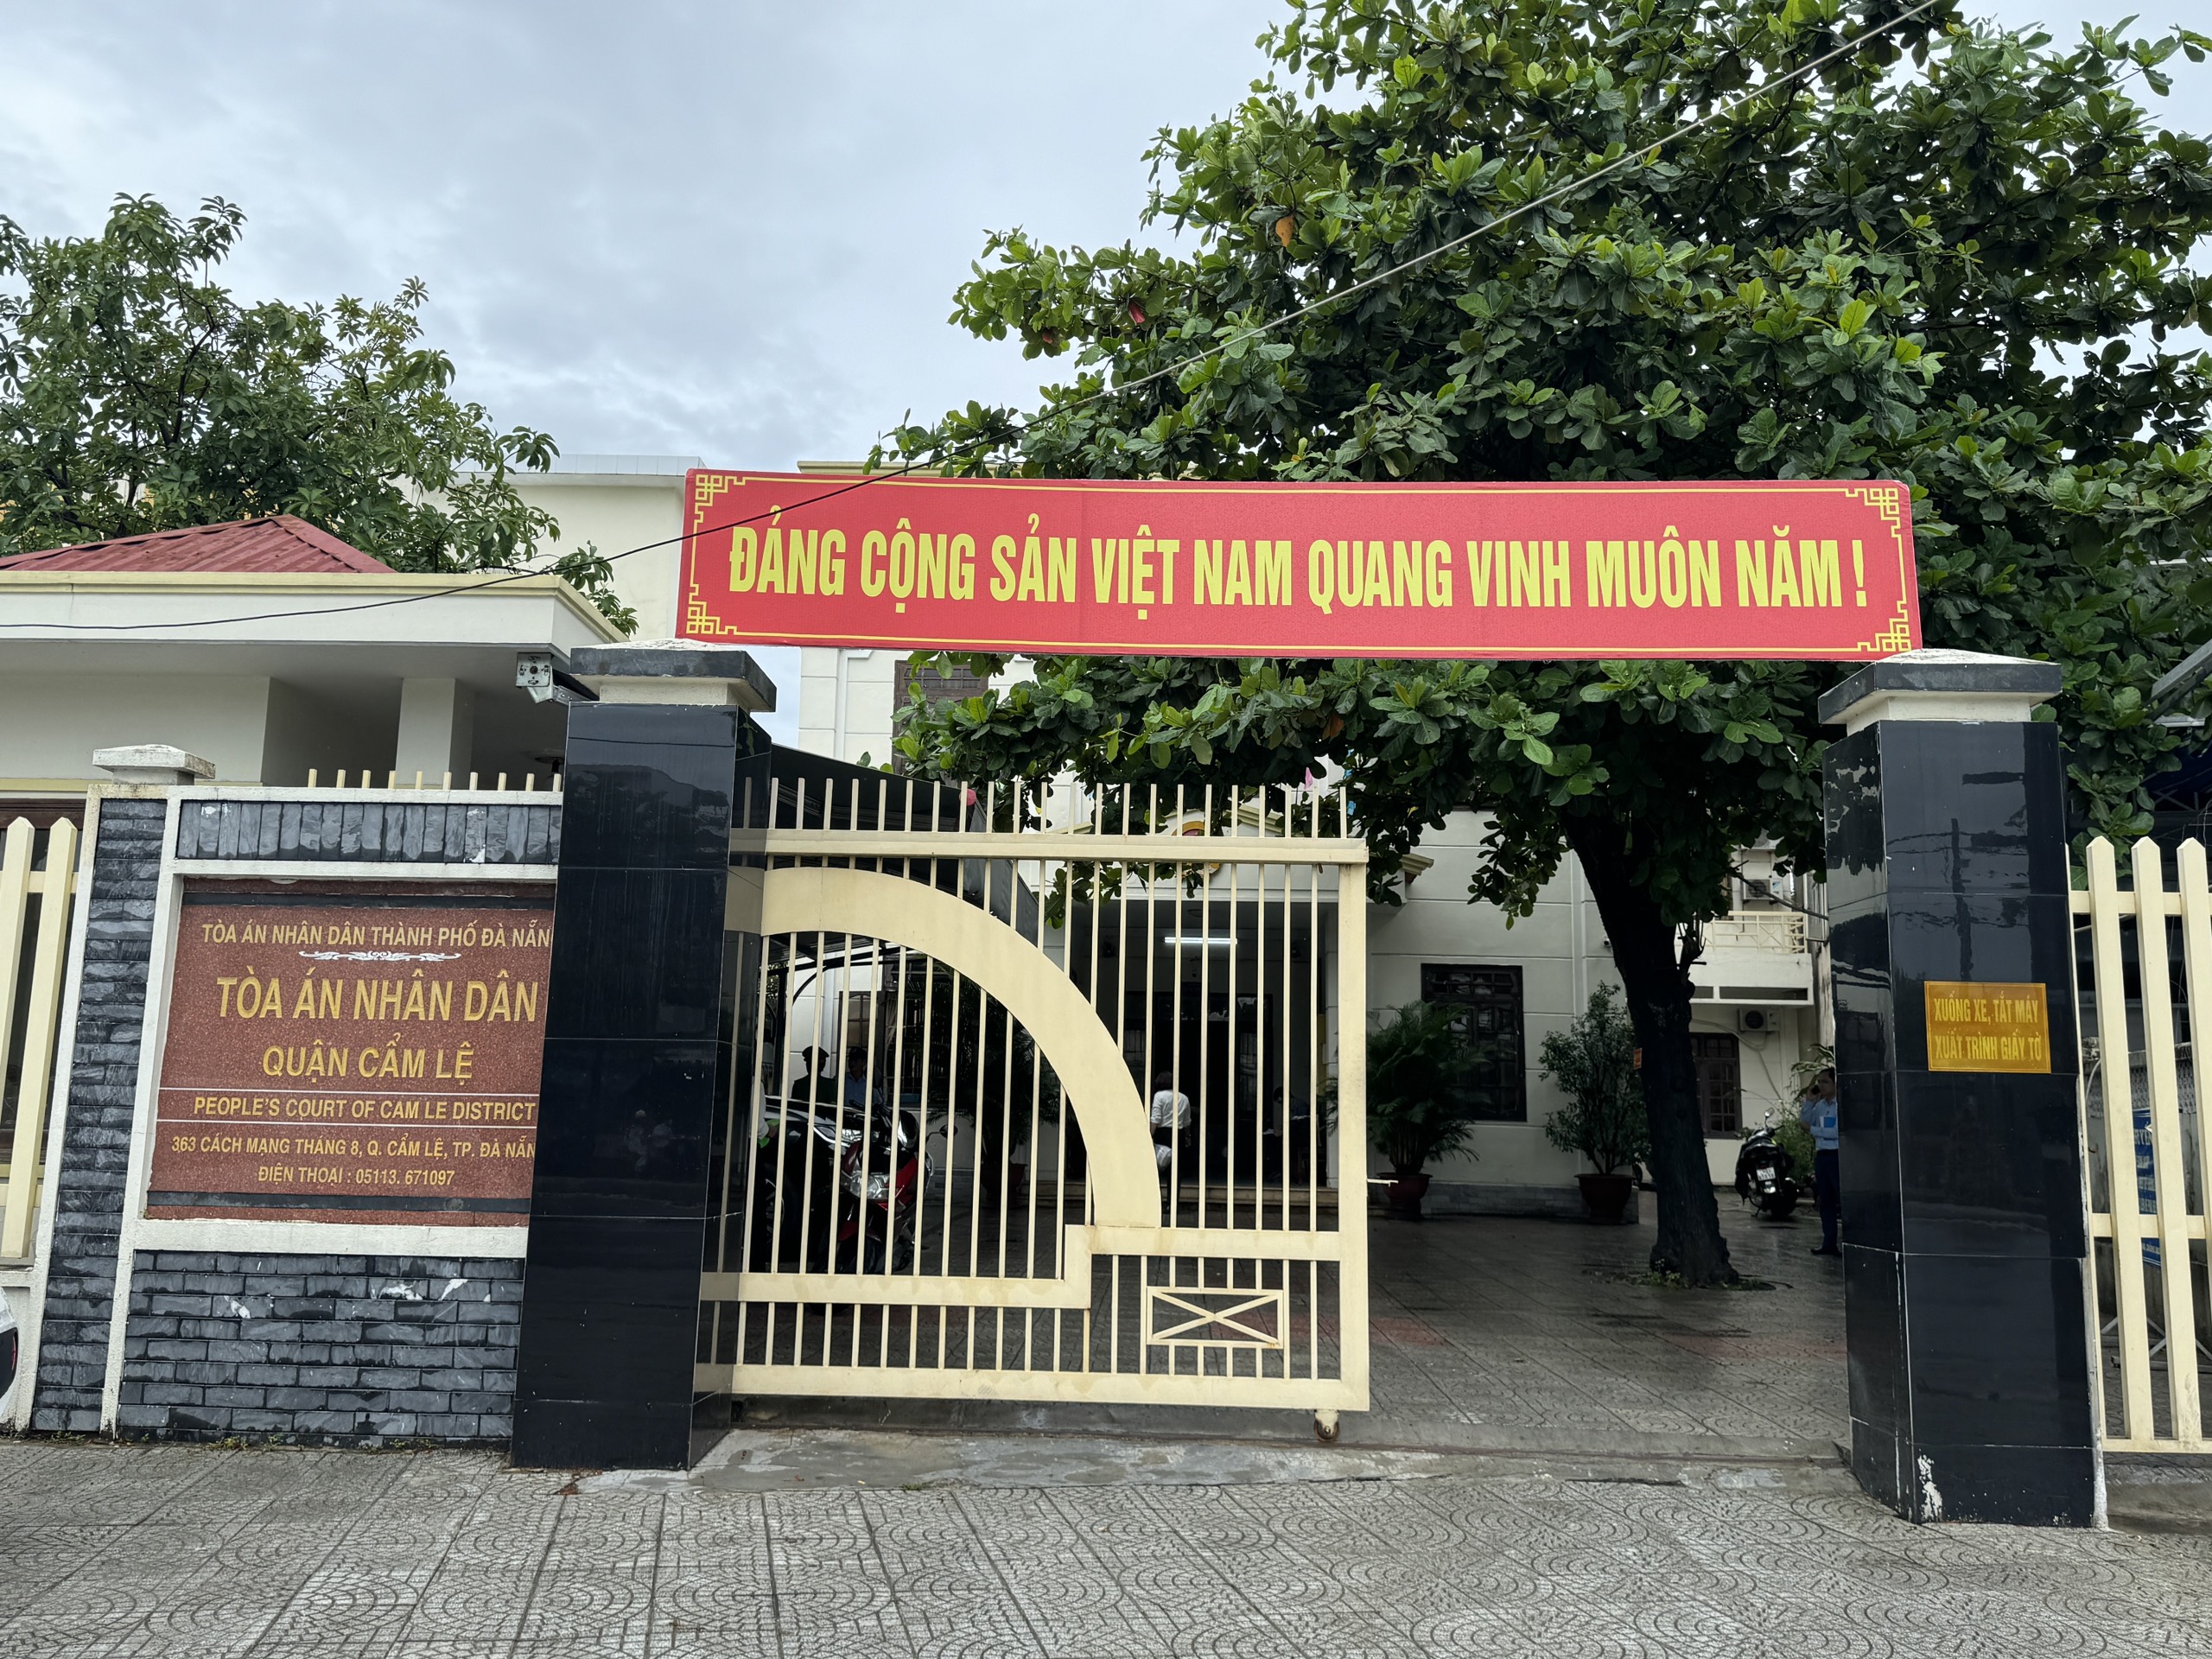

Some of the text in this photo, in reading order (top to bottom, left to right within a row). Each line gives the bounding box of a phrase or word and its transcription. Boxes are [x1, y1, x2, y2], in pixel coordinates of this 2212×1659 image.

[729, 505, 1867, 620] ĐẢNG CỘNG SẢN VIỆT NAM QUANG VINH MUÔN NĂM !
[201, 918, 550, 947] TÒA ÁN NHÂN DÂN THÀNH PHỐ ĐÀ NẴN
[217, 965, 538, 1022] TÒA ÁN NHÂN DÂN
[1934, 990, 2039, 1025] XUỐNG XE, TẮT MÁY
[263, 1032, 474, 1085] QUẬN CẨM LỆ
[1935, 1027, 2042, 1061] XUẤT TRÌNH GIẤY TỜ
[285, 1098, 347, 1117] COURT
[351, 1100, 375, 1119] OF
[379, 1101, 419, 1119] CAM
[424, 1102, 448, 1120] LE
[452, 1102, 536, 1121] DISTRICT
[171, 1133, 536, 1160] 363 CÁCH MẠNG THÁNG 8, Q. CẨM LỆ, TP. ĐÀ NẴN
[258, 1162, 294, 1185] ĐIỆN
[298, 1166, 343, 1186] THOẠI
[356, 1168, 400, 1185] 05113.
[404, 1169, 455, 1185] 671097
